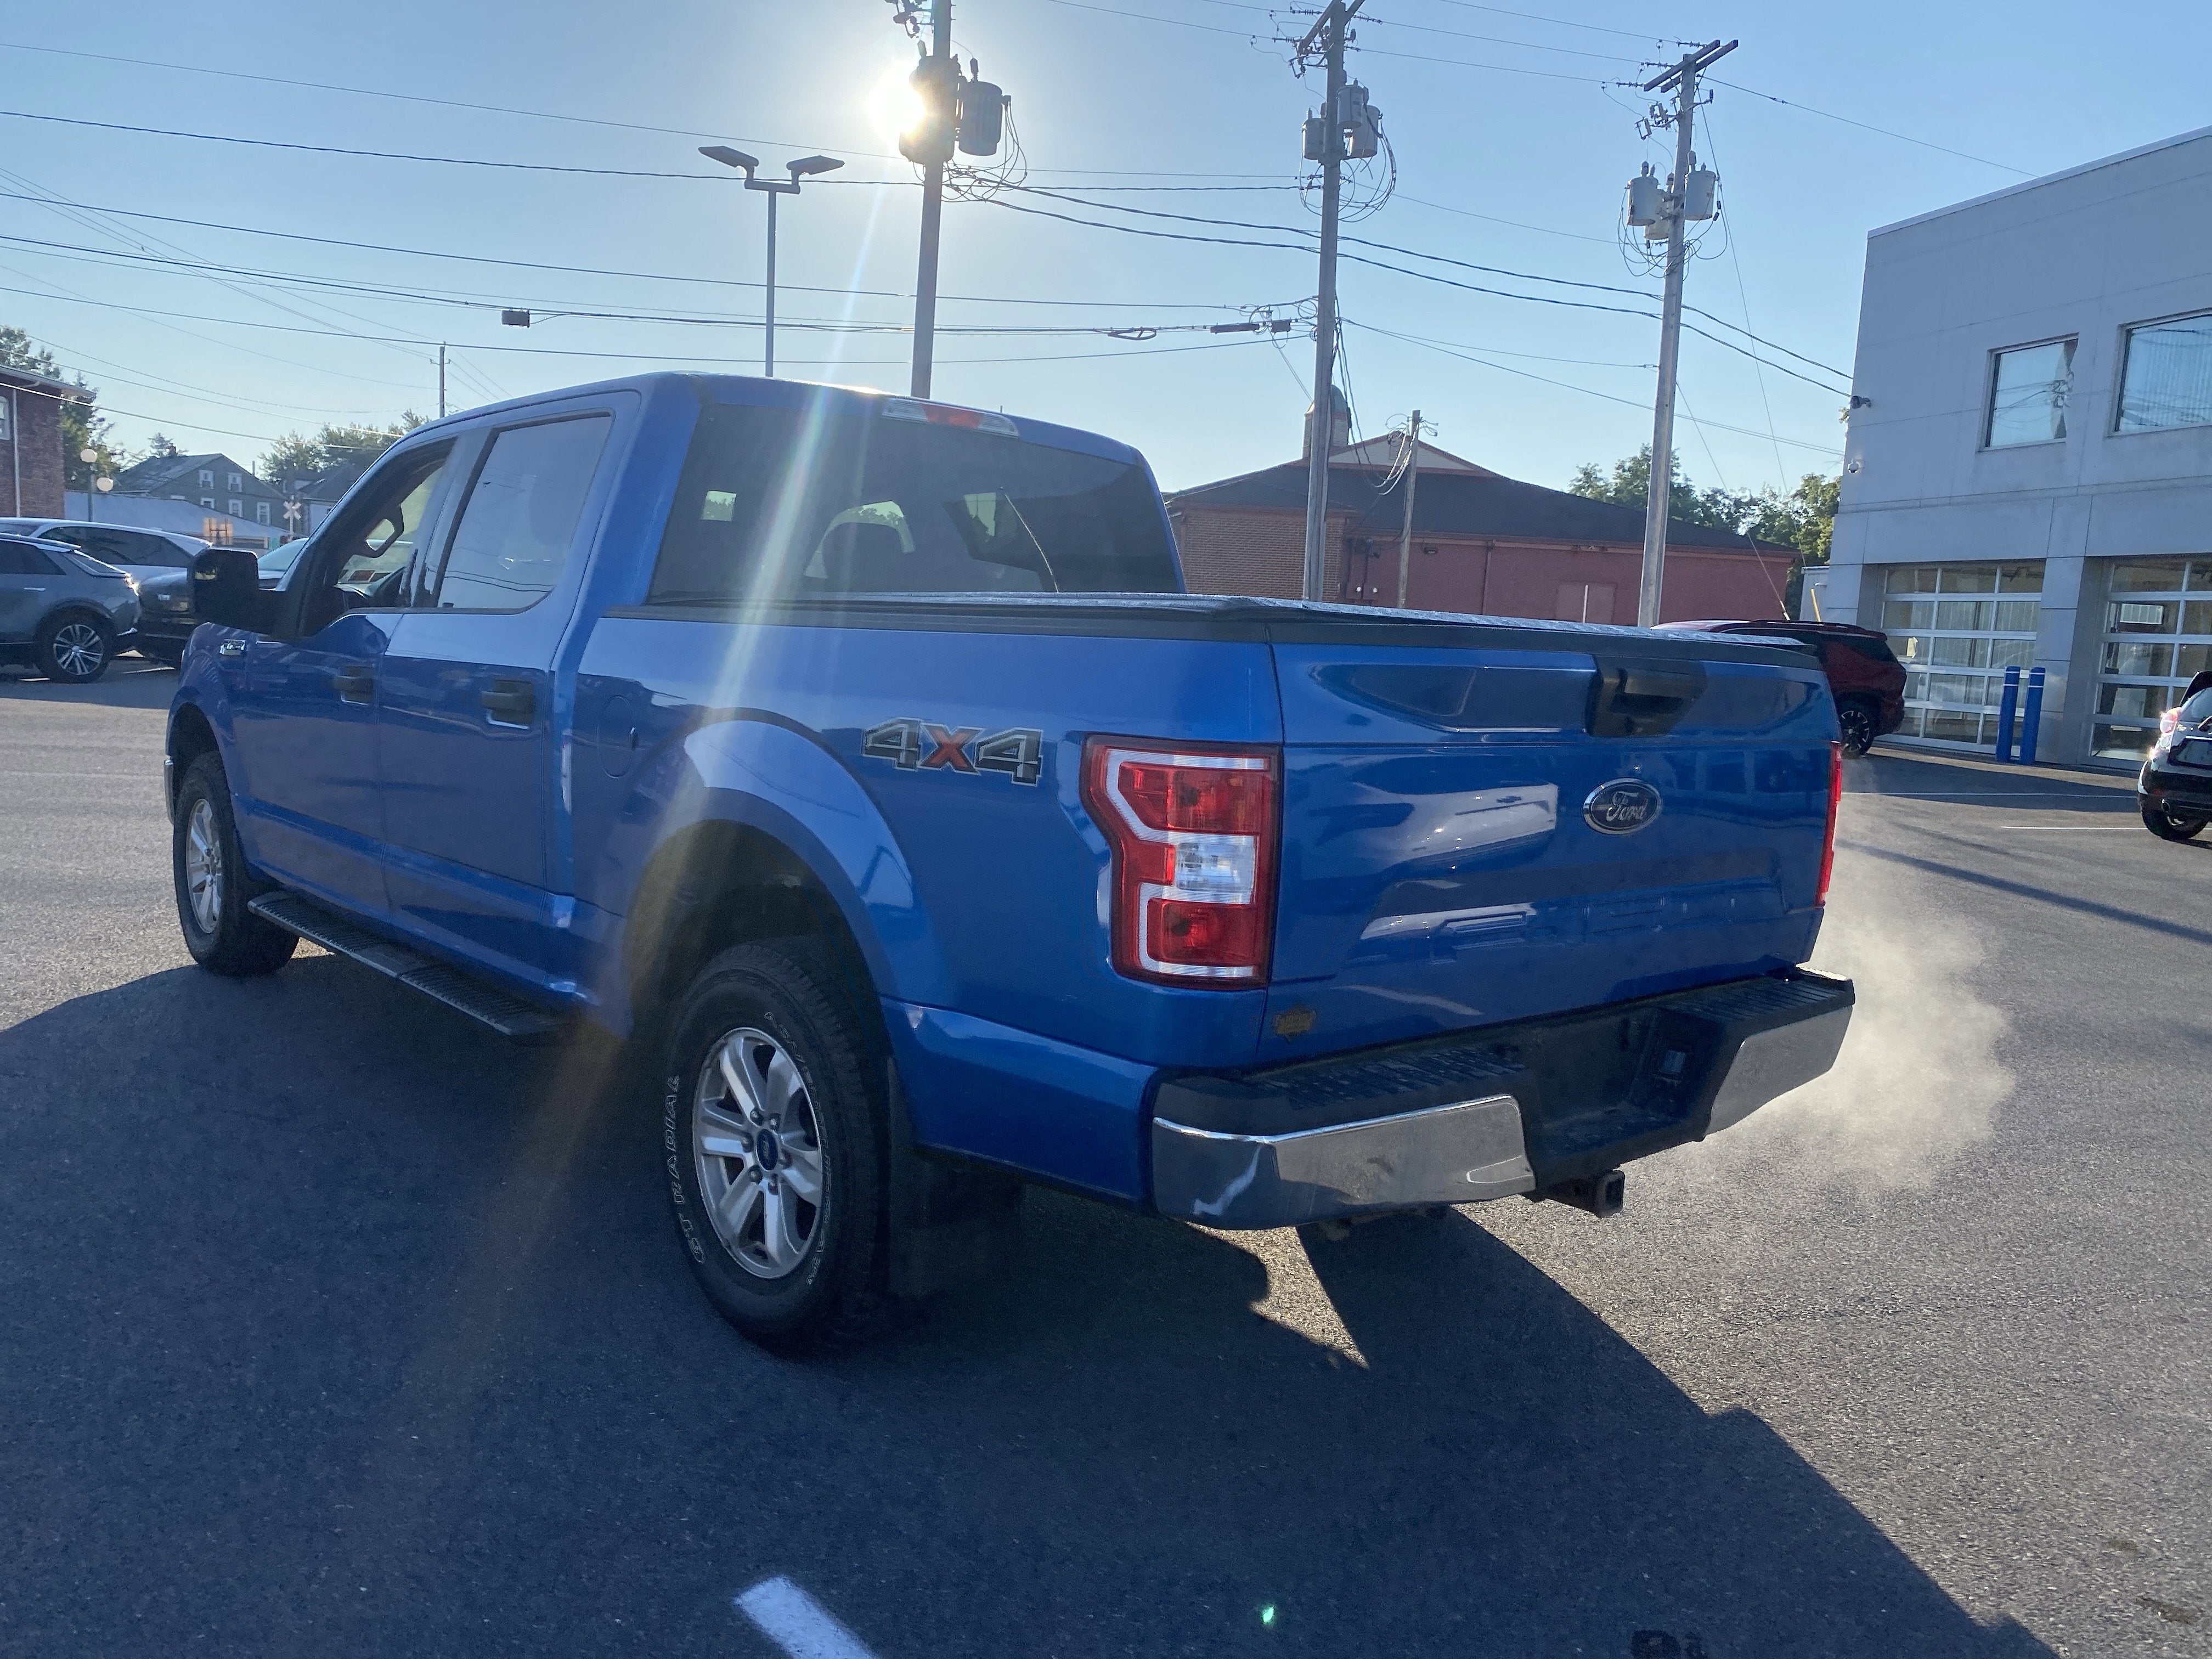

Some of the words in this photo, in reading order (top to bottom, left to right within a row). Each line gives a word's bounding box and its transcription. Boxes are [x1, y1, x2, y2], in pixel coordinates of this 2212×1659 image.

[1606, 791, 1649, 821] Ford
[665, 1075, 685, 1204] RADIAL
[678, 1214, 704, 1263] GT
